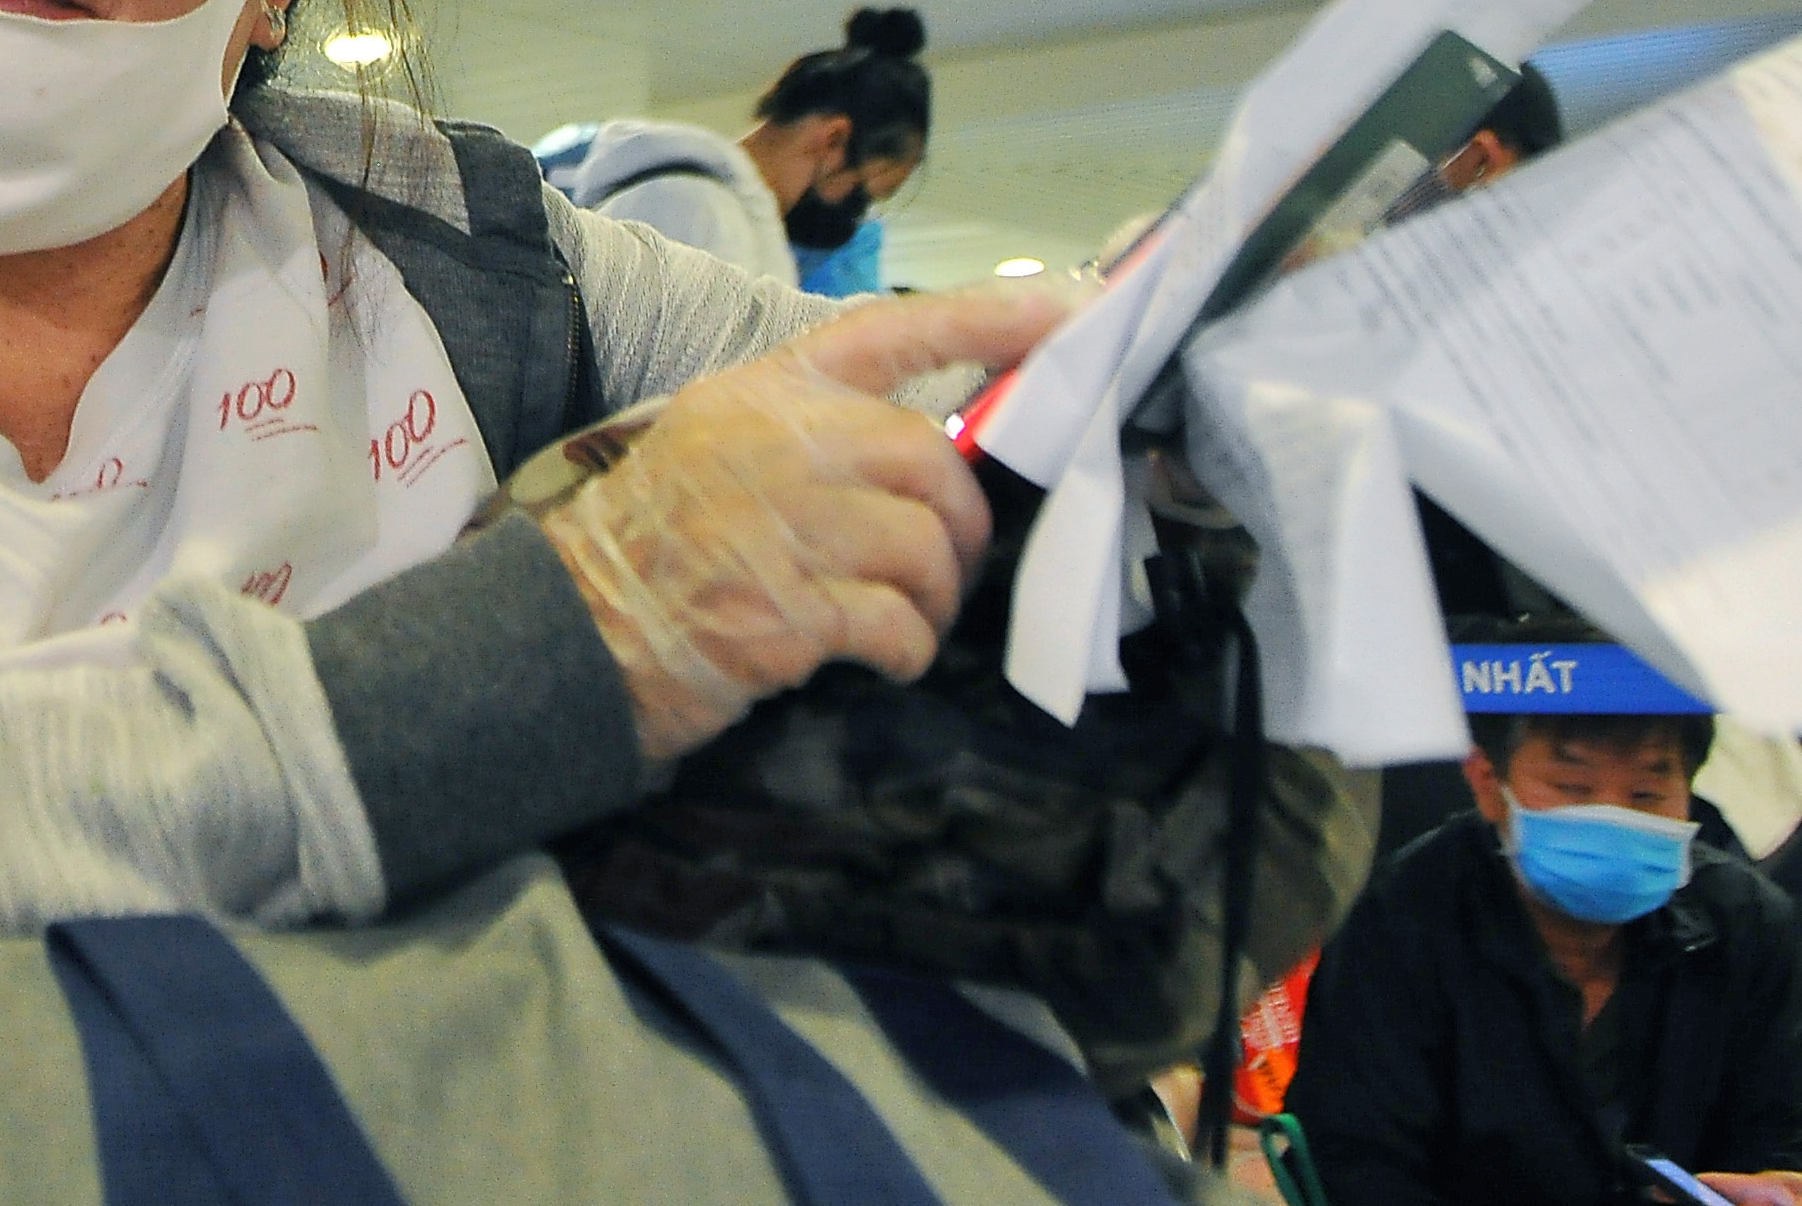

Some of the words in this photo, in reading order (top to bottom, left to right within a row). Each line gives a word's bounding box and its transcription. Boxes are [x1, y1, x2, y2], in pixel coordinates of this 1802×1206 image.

[218, 368, 295, 431] 100
[367, 390, 435, 482] 100
[1462, 651, 1577, 694] NHẤT
